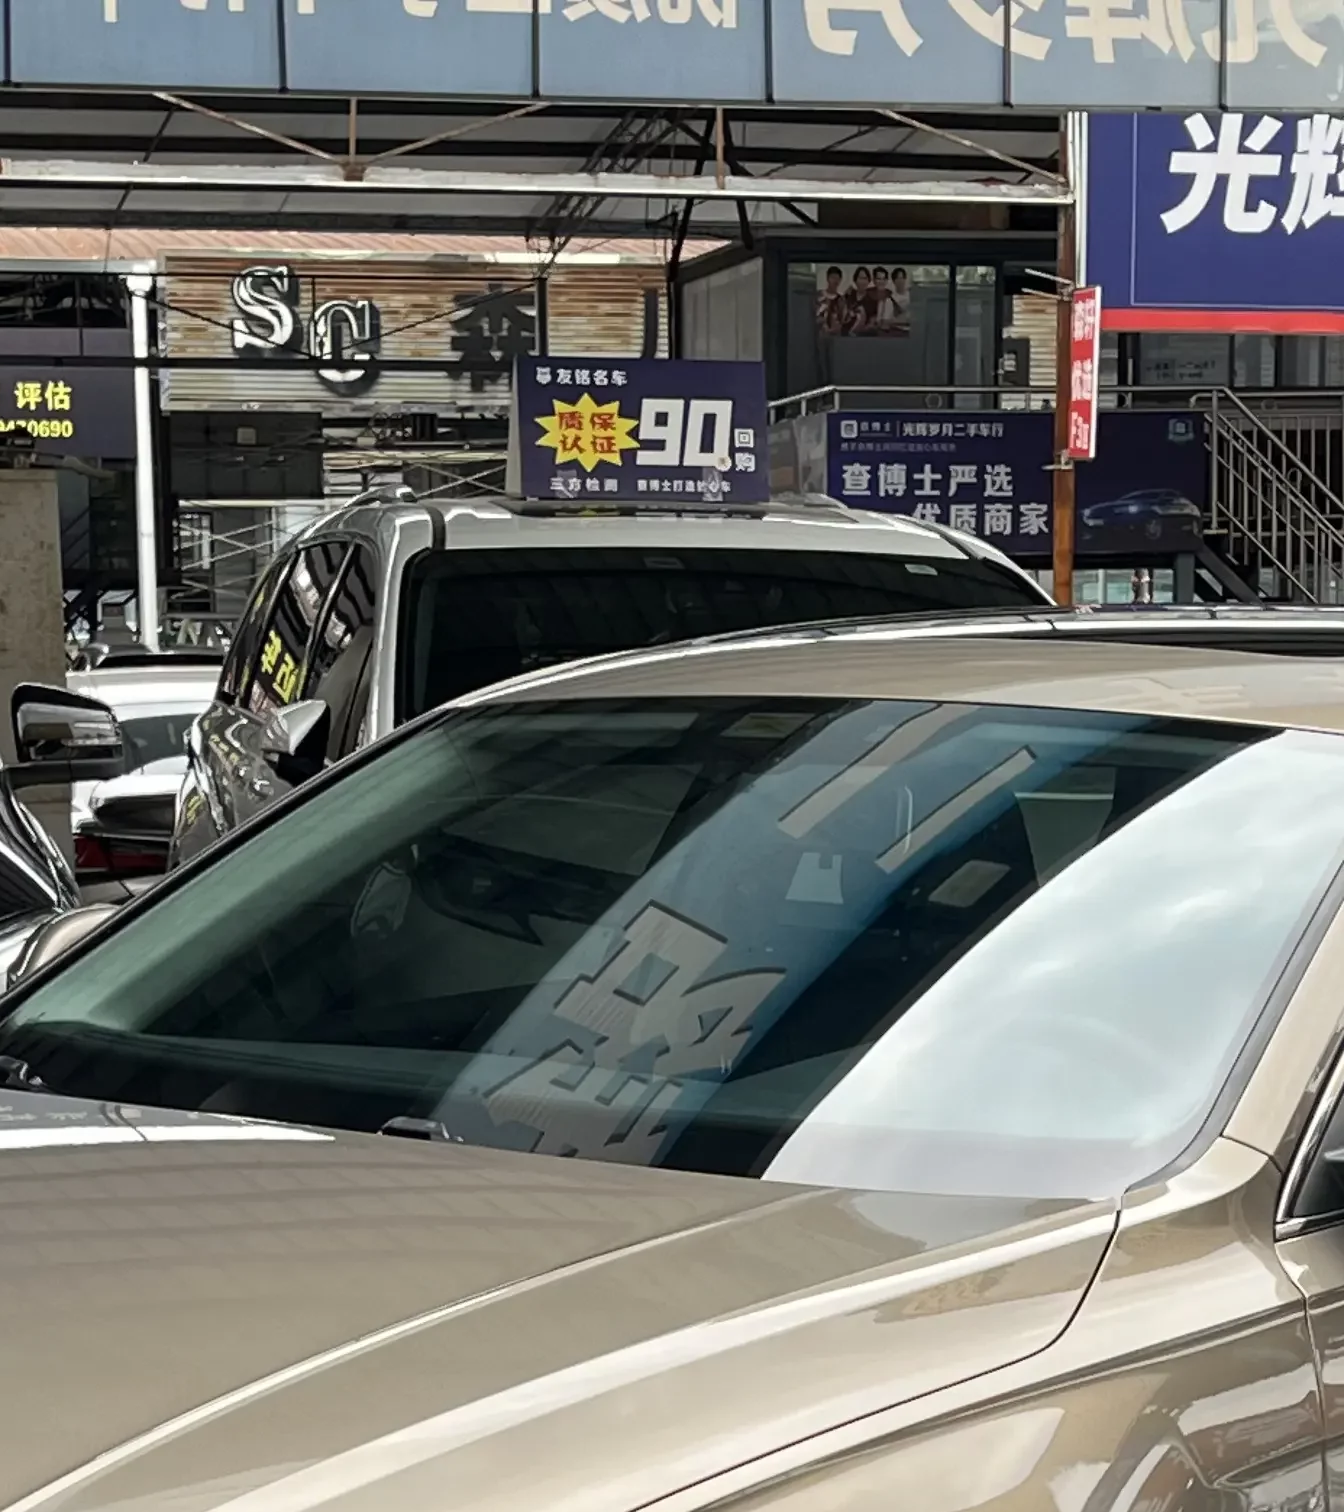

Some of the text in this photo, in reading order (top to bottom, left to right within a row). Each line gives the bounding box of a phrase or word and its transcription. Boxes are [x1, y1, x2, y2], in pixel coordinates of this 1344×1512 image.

[14, 380, 73, 411] 评估
[636, 398, 733, 466] 90
[841, 462, 1014, 498] 查博士严选
